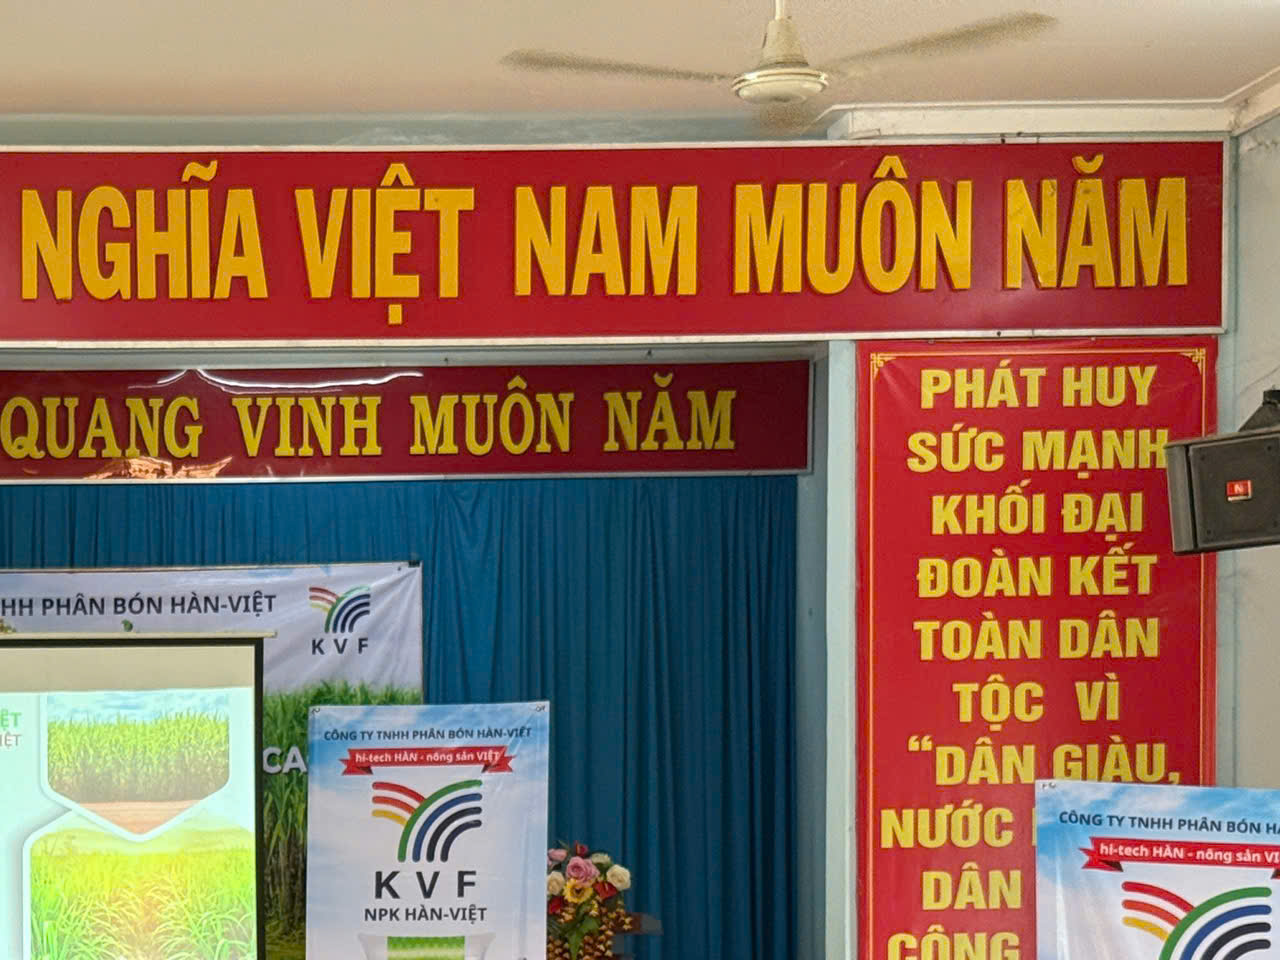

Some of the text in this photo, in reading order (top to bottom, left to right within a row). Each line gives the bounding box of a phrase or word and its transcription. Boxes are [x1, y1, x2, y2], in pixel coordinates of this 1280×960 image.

[21, 159, 269, 300] NGHĨA
[295, 162, 475, 325] VIỆT
[514, 186, 698, 296] NAM
[734, 154, 973, 295] MUÔN
[1005, 154, 1188, 289] NĂM
[920, 358, 1157, 409] PHÁT HUY
[0, 395, 203, 458] QUANG
[231, 395, 382, 457] VINH
[409, 375, 574, 456] MUÔN
[604, 374, 736, 451] NĂM
[906, 423, 1170, 479] SỨC MẠNH
[931, 479, 1143, 542] KHỐI ĐẠI
[916, 543, 1158, 598] ĐOÀN KẾT
[42, 594, 101, 616] PHÂN
[113, 592, 163, 615] BÓN
[171, 590, 277, 616] HÀN-VIỆT
[914, 609, 1160, 661] TOÀN DÂN
[952, 672, 1120, 732] TỘC VÌ
[324, 728, 357, 741] CÔNG
[361, 731, 374, 740] TY
[377, 731, 409, 740] TNHH
[412, 728, 445, 740] PHÂN
[448, 728, 473, 739] BÓN
[355, 750, 501, 763] hi-tech HÀN nông sản VIỆT
[907, 735, 1181, 785] “DÂN GIÀU,
[880, 800, 1014, 850] NƯỚC
[1059, 811, 1103, 826] CÔNG
[1106, 815, 1125, 827] TY
[1128, 816, 1173, 830] TNHH
[1177, 816, 1222, 832] PHÂN
[1226, 820, 1261, 835] BÓN
[1099, 843, 1261, 863] hi-tech HÀN nông sản
[922, 862, 1022, 911] DÂN
[364, 903, 487, 924] NPK HÀN-VIỆT
